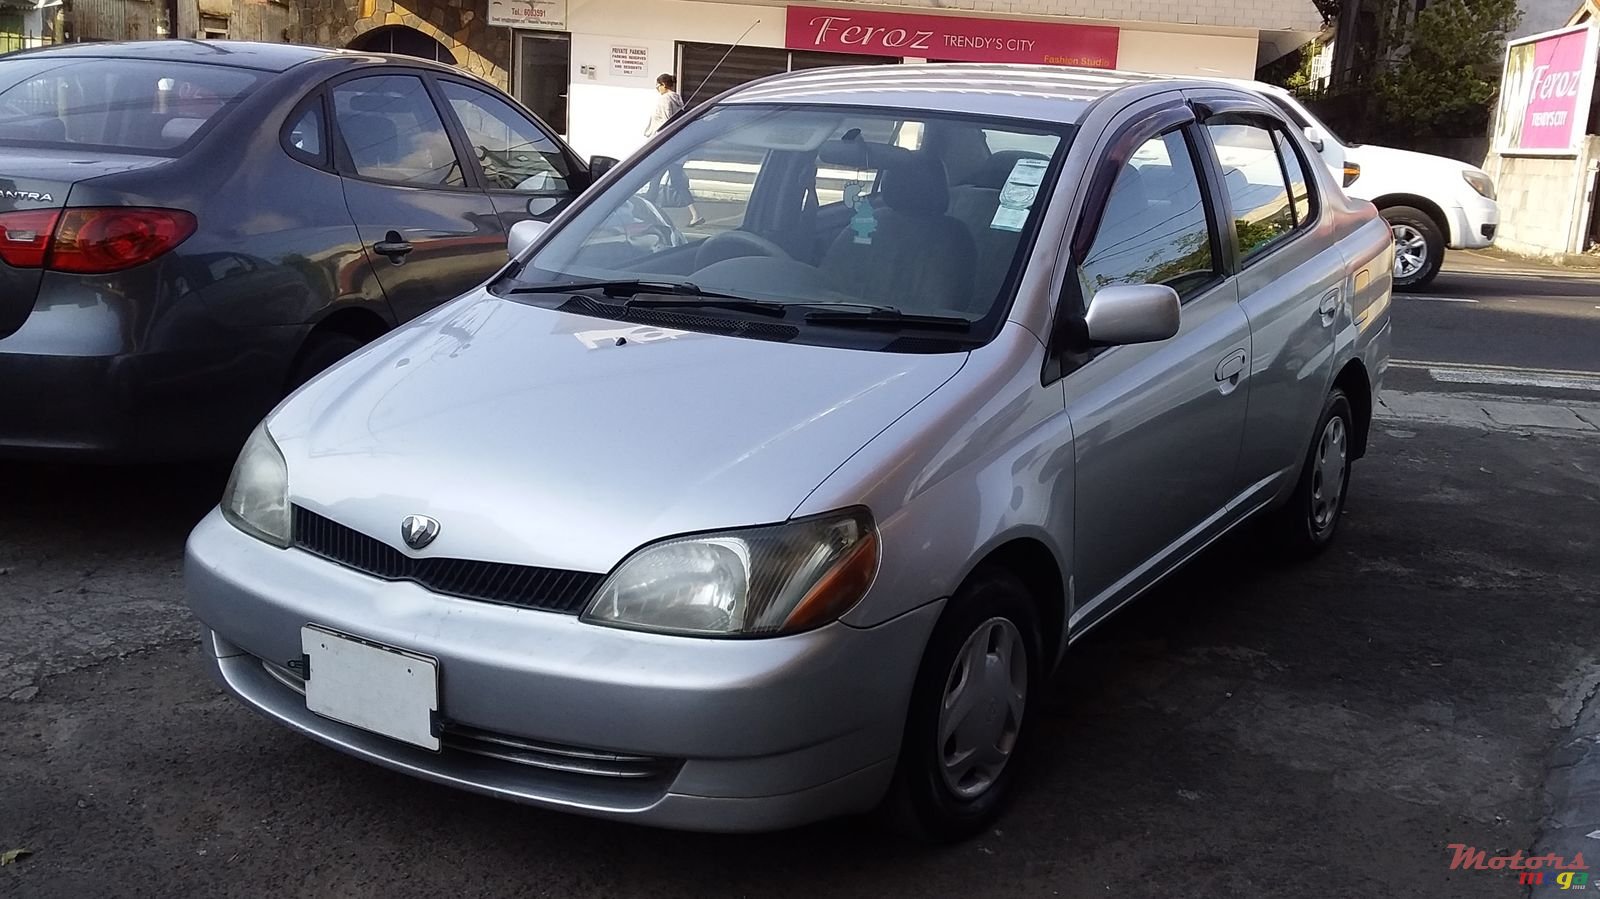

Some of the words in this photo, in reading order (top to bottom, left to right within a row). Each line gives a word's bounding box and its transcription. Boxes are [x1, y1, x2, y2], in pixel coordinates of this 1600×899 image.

[809, 16, 934, 49] Feroz
[943, 34, 1003, 50] TRENDY'S
[1006, 39, 1036, 52] CITY
[1043, 54, 1079, 65] Fashion
[1080, 57, 1110, 67] Studio
[1529, 64, 1581, 105] Feroz
